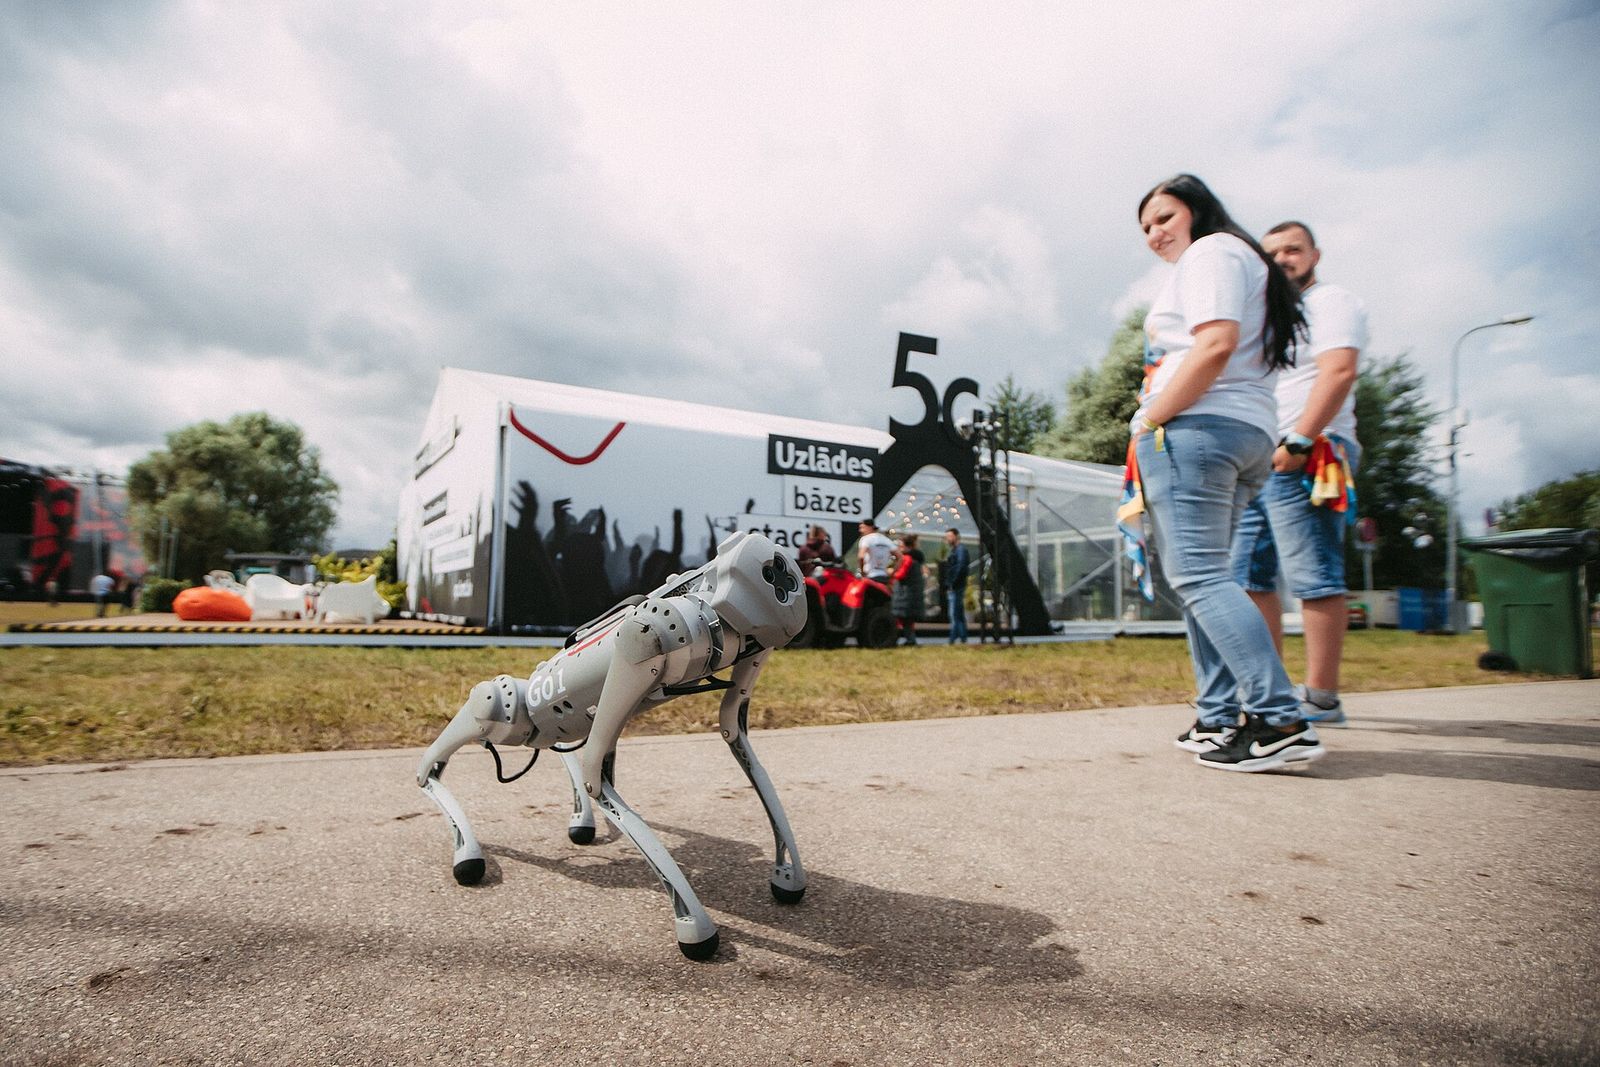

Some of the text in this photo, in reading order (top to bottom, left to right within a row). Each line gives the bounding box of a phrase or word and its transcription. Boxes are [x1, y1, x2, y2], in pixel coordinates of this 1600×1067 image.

[889, 331, 983, 443] 5G
[775, 440, 873, 478] Uzlādes
[794, 485, 862, 515] bāzes
